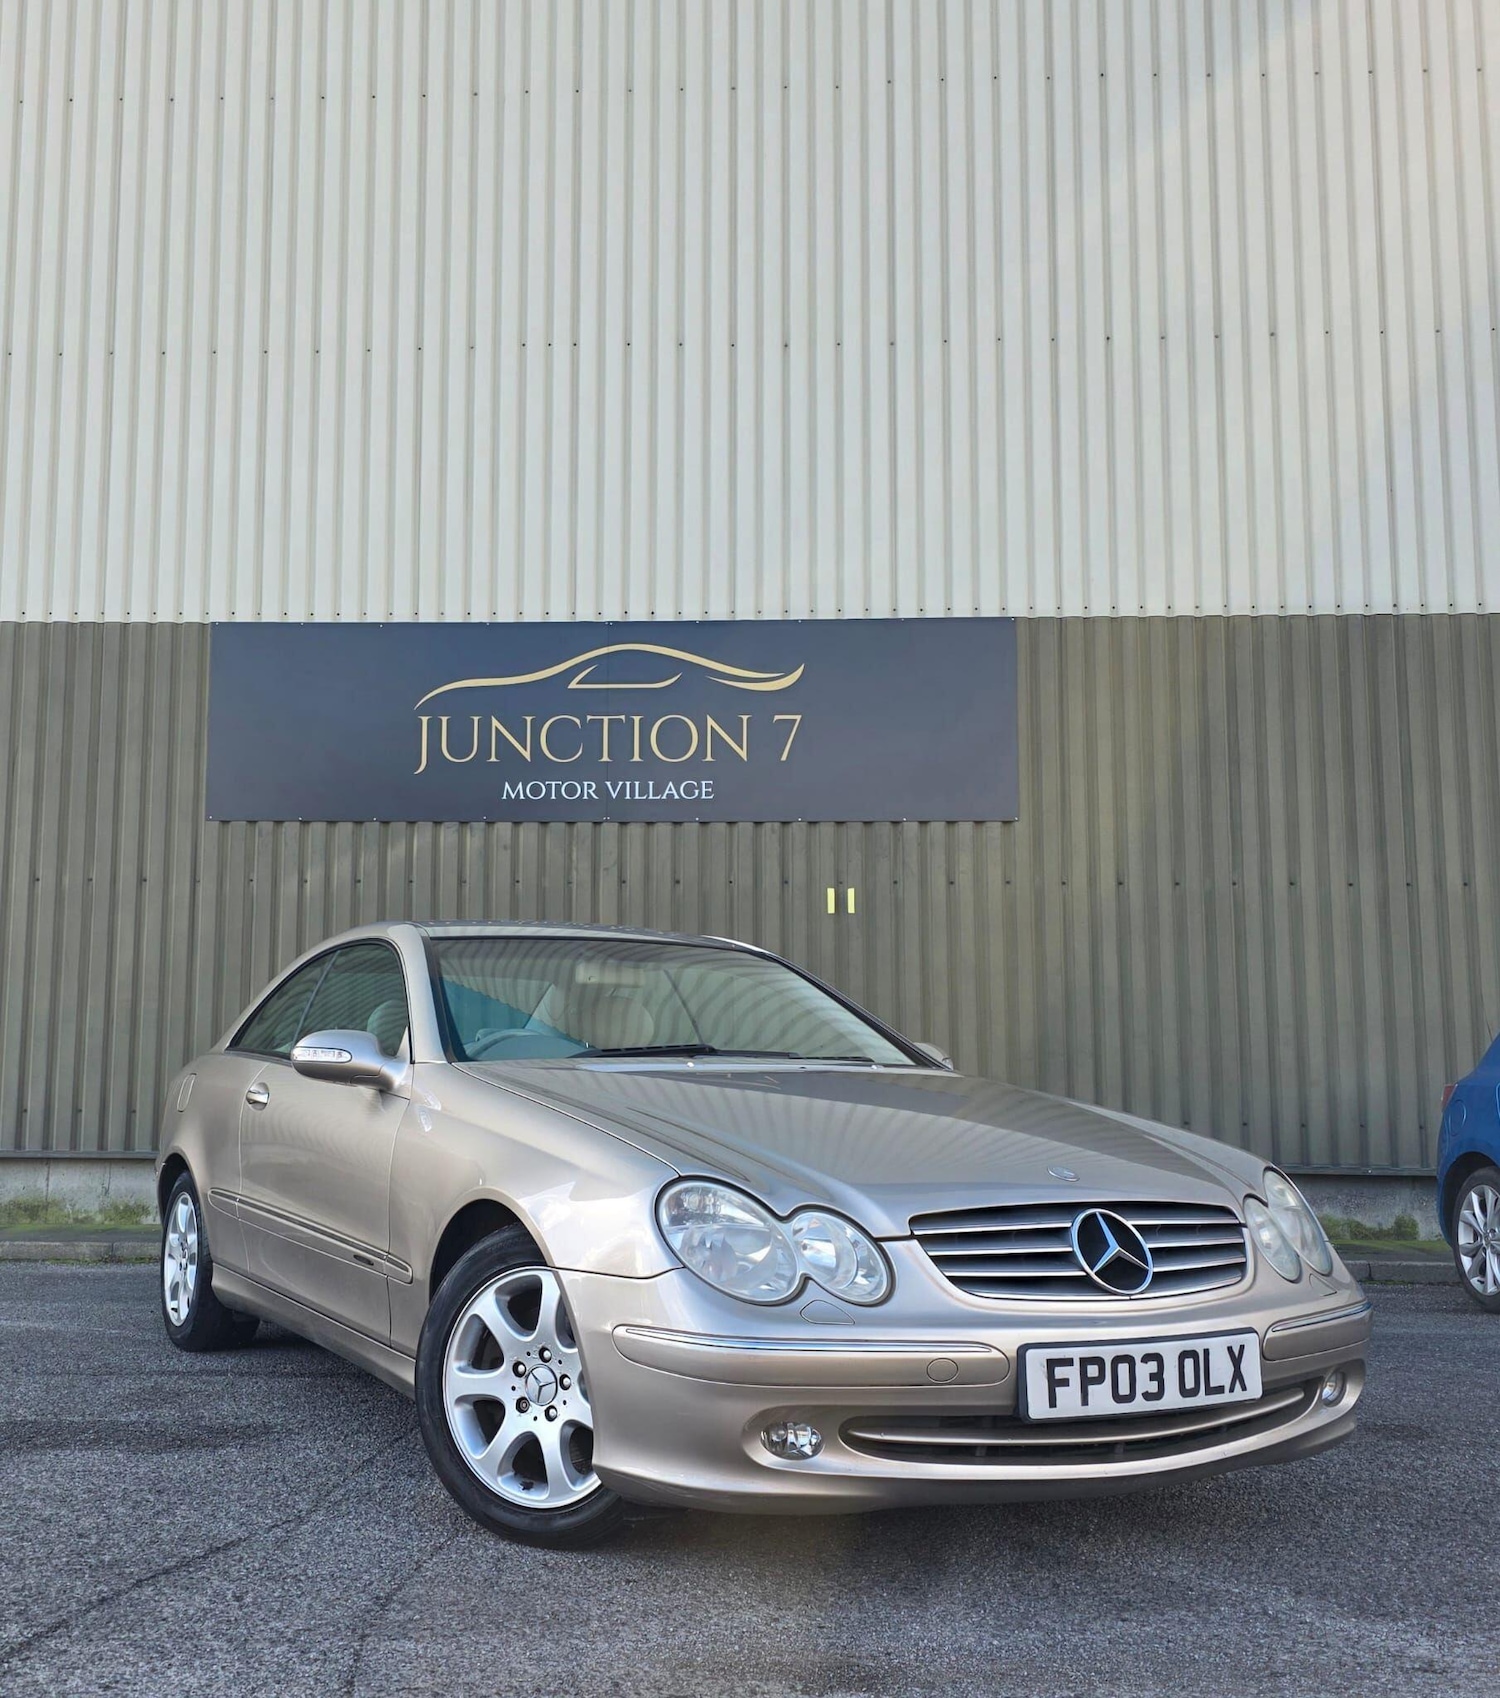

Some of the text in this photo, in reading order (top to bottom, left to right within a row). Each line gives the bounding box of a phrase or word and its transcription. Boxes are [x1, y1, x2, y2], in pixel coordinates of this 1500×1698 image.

[414, 714, 802, 775] JUNCTION 7
[502, 781, 715, 800] MOTOR VILLAGE
[1046, 1344, 1248, 1409] FP03 OLX
